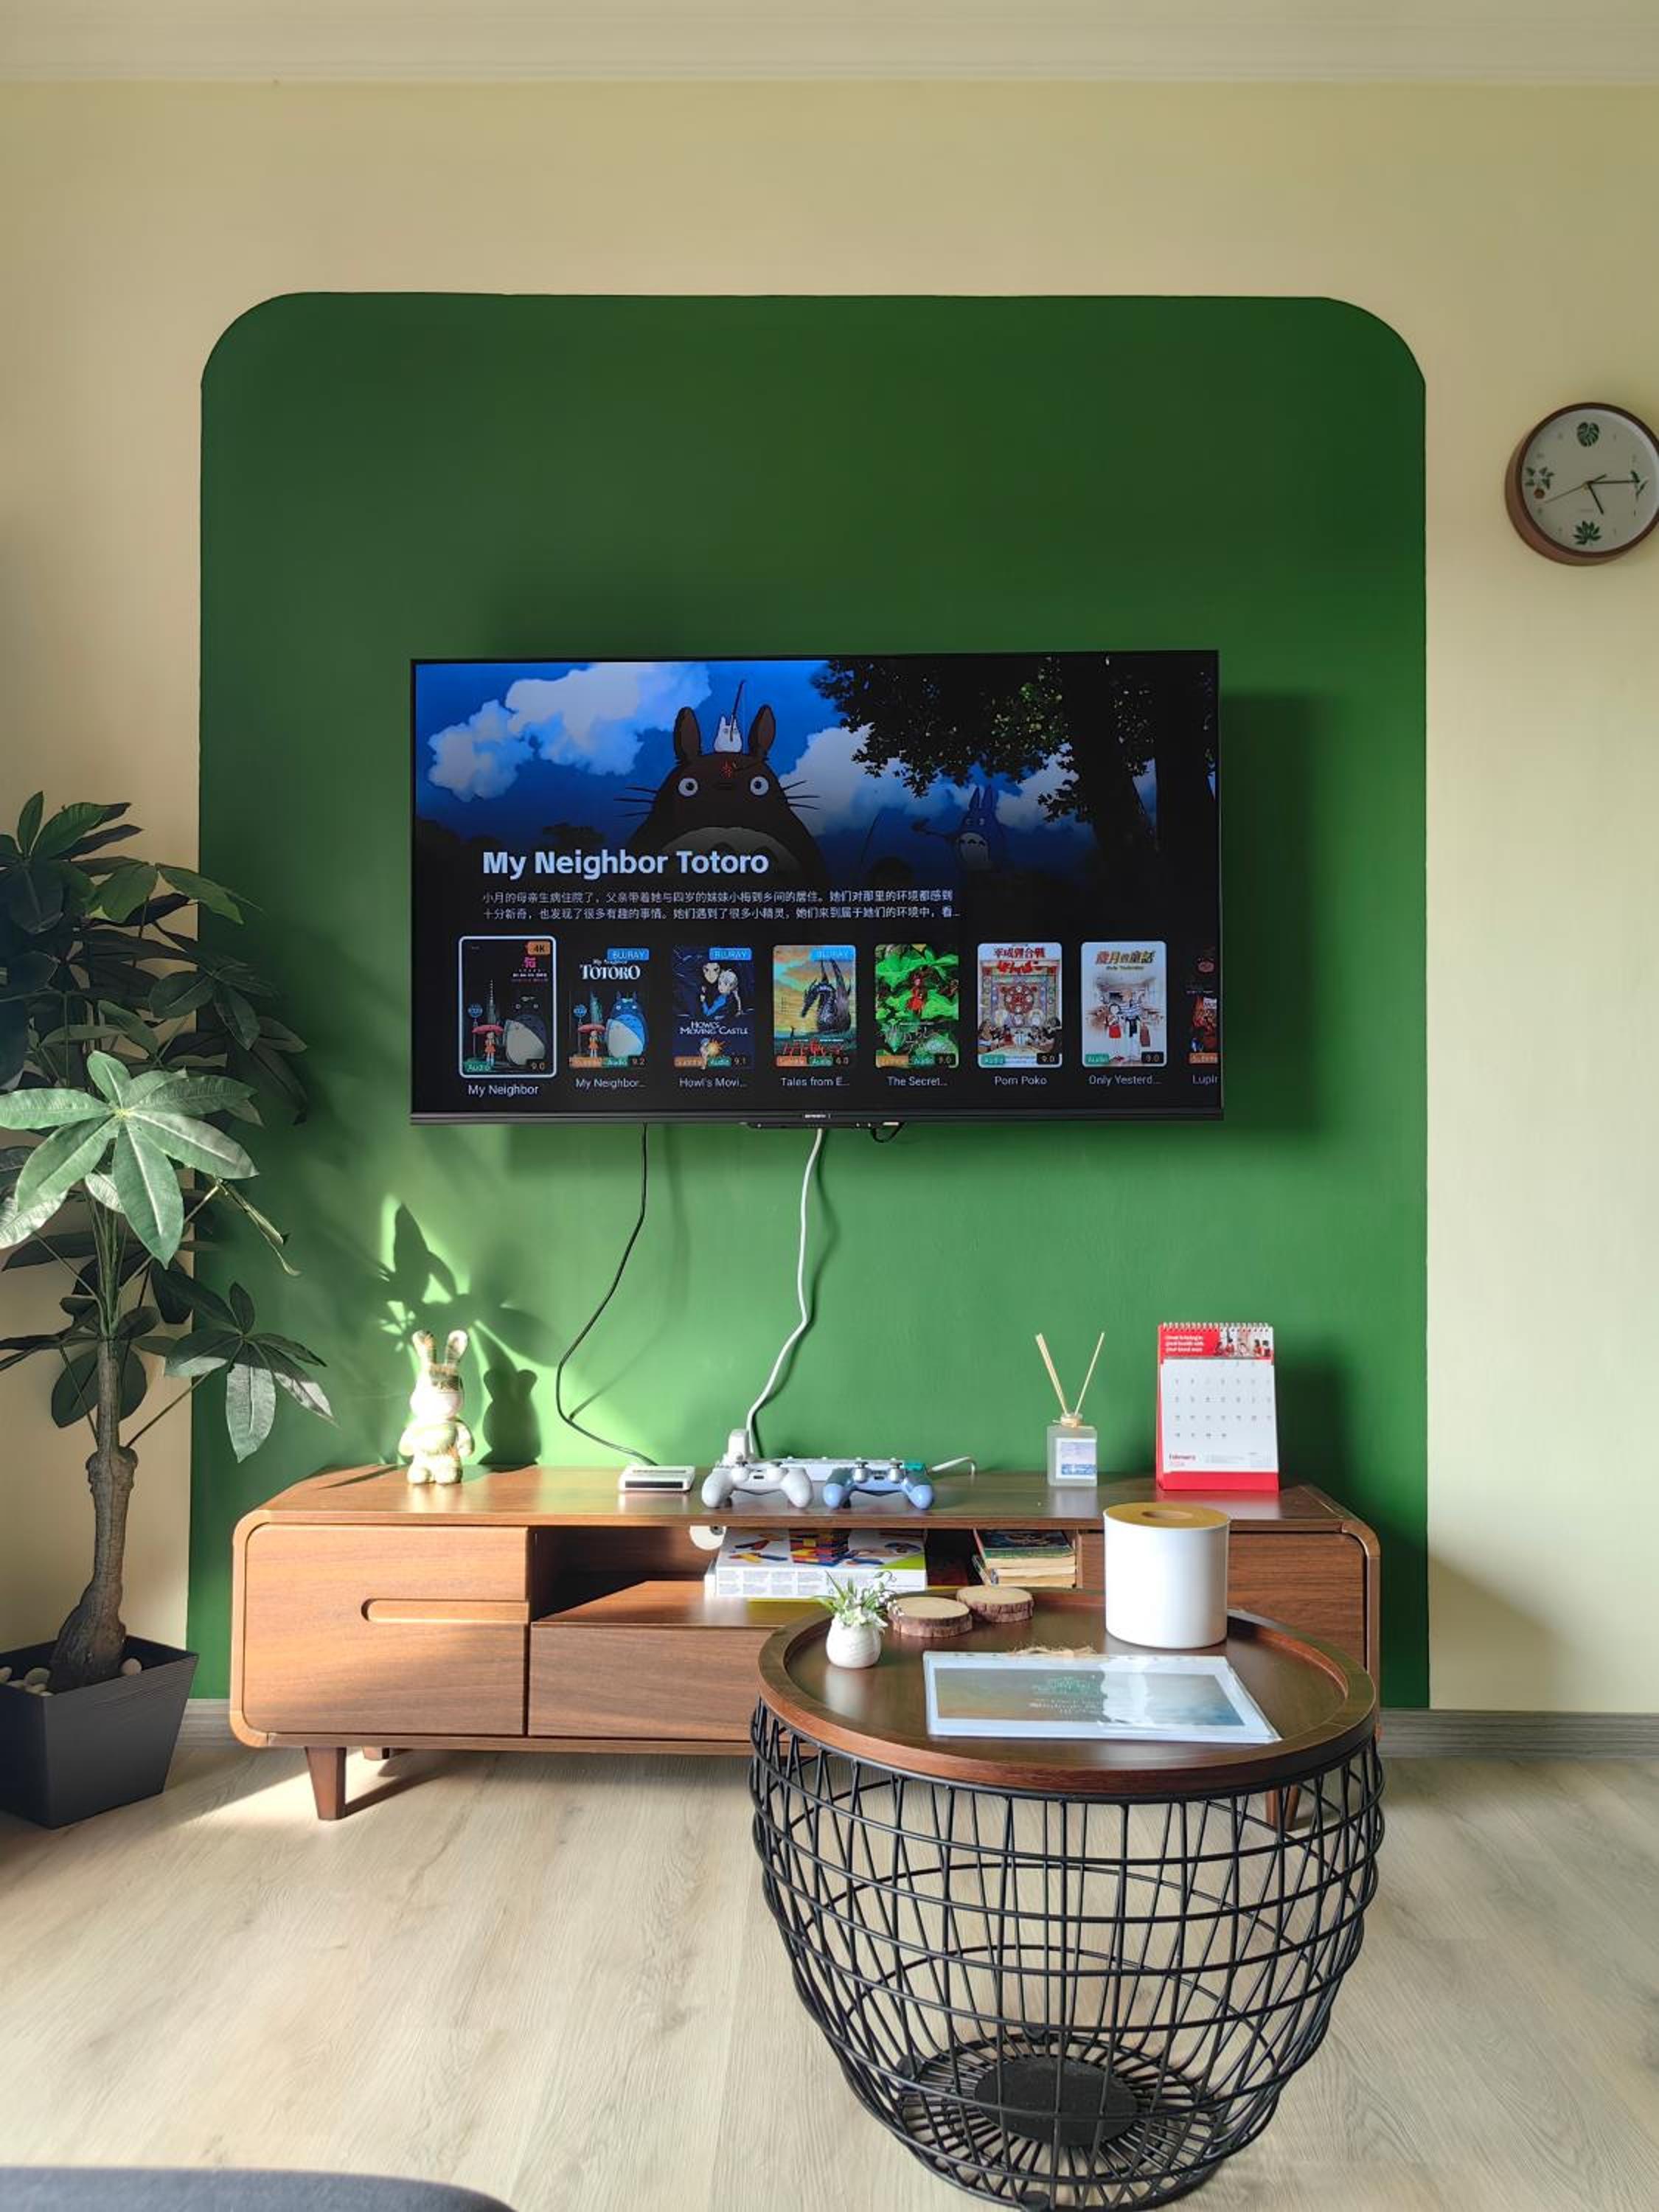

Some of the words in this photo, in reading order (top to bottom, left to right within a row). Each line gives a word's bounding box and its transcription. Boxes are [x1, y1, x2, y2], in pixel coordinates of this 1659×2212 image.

[483, 851, 527, 880] My
[535, 849, 668, 880] Neighbor
[676, 850, 769, 874] Totoro
[534, 944, 545, 953] 4K
[579, 964, 641, 980] TOTORO
[680, 1026, 715, 1034] MOVING
[719, 1026, 748, 1034] CASTLE
[576, 1078, 591, 1090] My
[679, 1077, 713, 1088] Howl's
[781, 1077, 807, 1086] Tales
[810, 1076, 834, 1086] from
[887, 1076, 906, 1086] The
[995, 1075, 1018, 1085] Pom
[1021, 1075, 1047, 1085] Poko
[1089, 1074, 1111, 1086] Only
[468, 1085, 484, 1097] My
[489, 1085, 538, 1097] Neighbor
